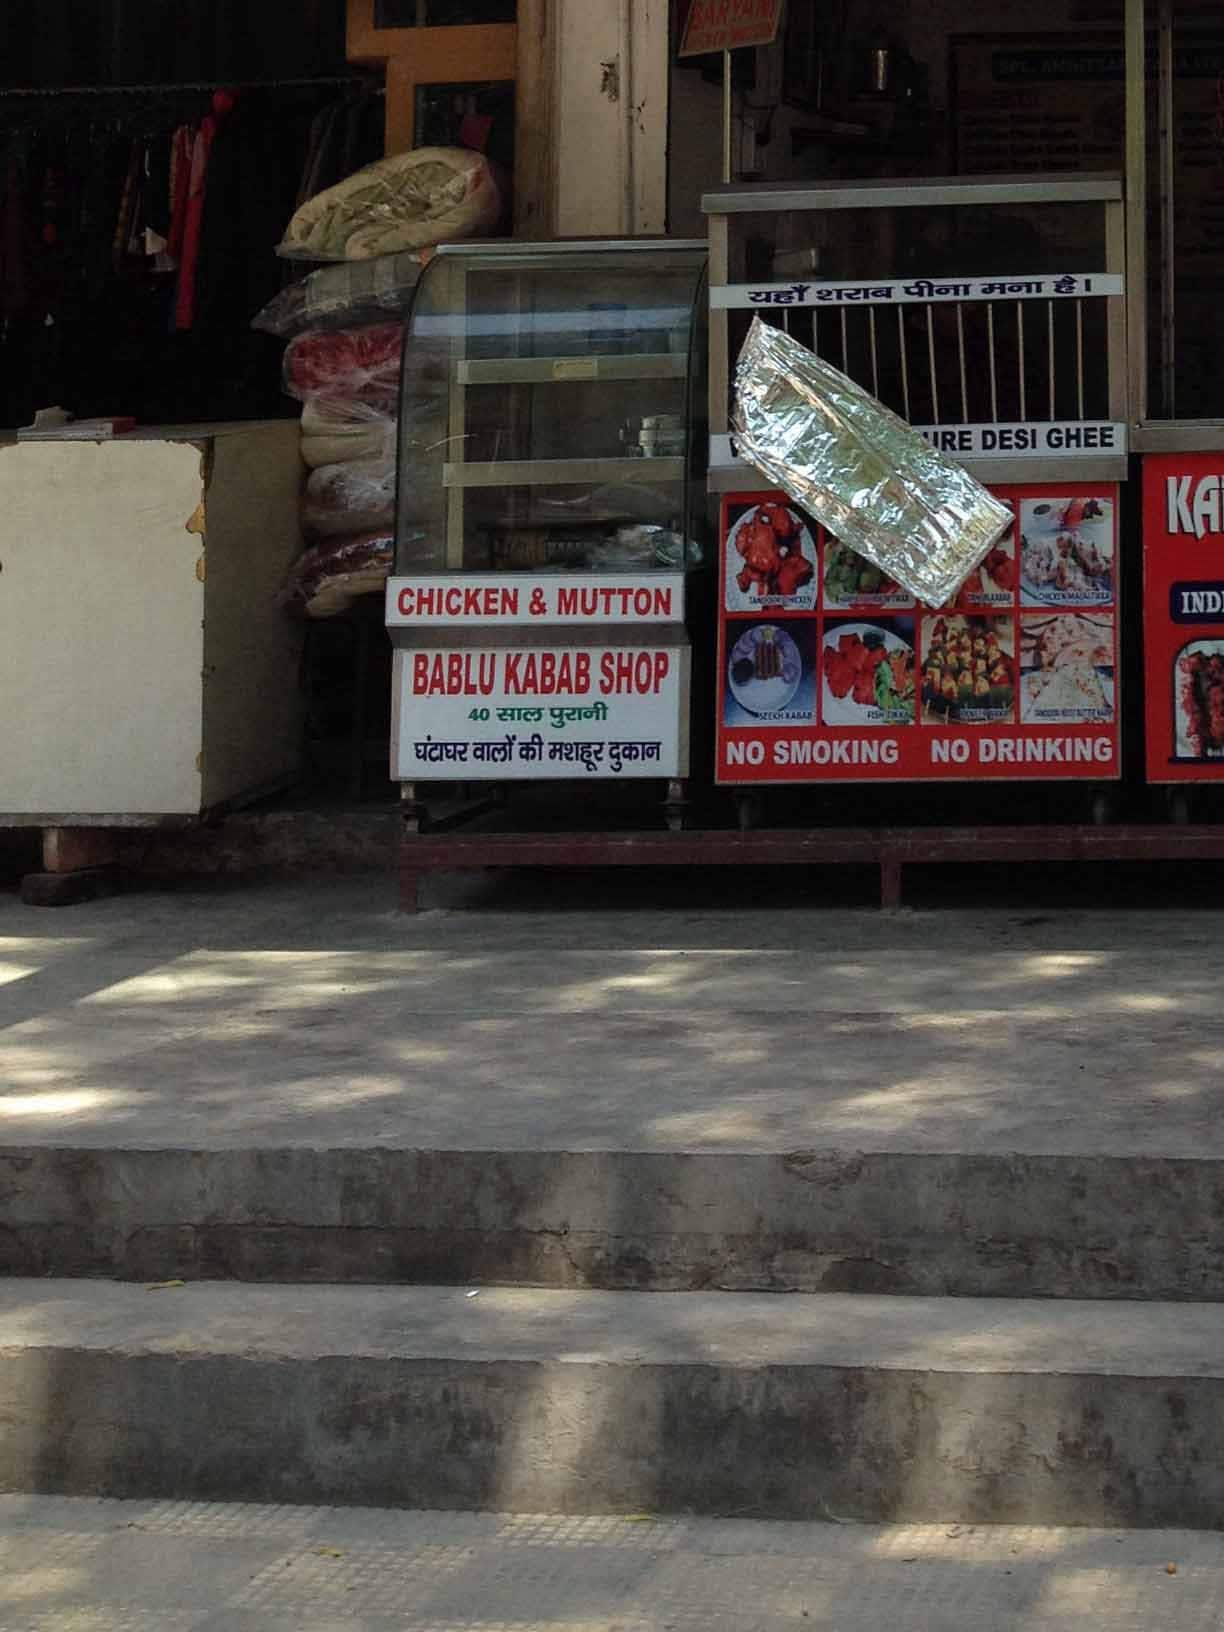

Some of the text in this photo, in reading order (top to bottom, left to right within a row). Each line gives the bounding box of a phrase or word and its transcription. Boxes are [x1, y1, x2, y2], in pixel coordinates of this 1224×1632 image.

[747, 283, 808, 305] यहाँ
[815, 285, 892, 303] शराब
[904, 277, 972, 299] पीना
[982, 278, 1042, 296] मना
[924, 426, 1114, 453] URE DESI GHEE
[398, 587, 672, 617] CHICKEN & MUTTON
[413, 651, 670, 696] BABLU KABAB SHOP
[468, 701, 608, 729] 40 साल पुरानी
[414, 733, 662, 772] घंटाघर वालों की मशहूर दुकान
[726, 736, 1113, 765] NO SMOKING NO DRINKING
